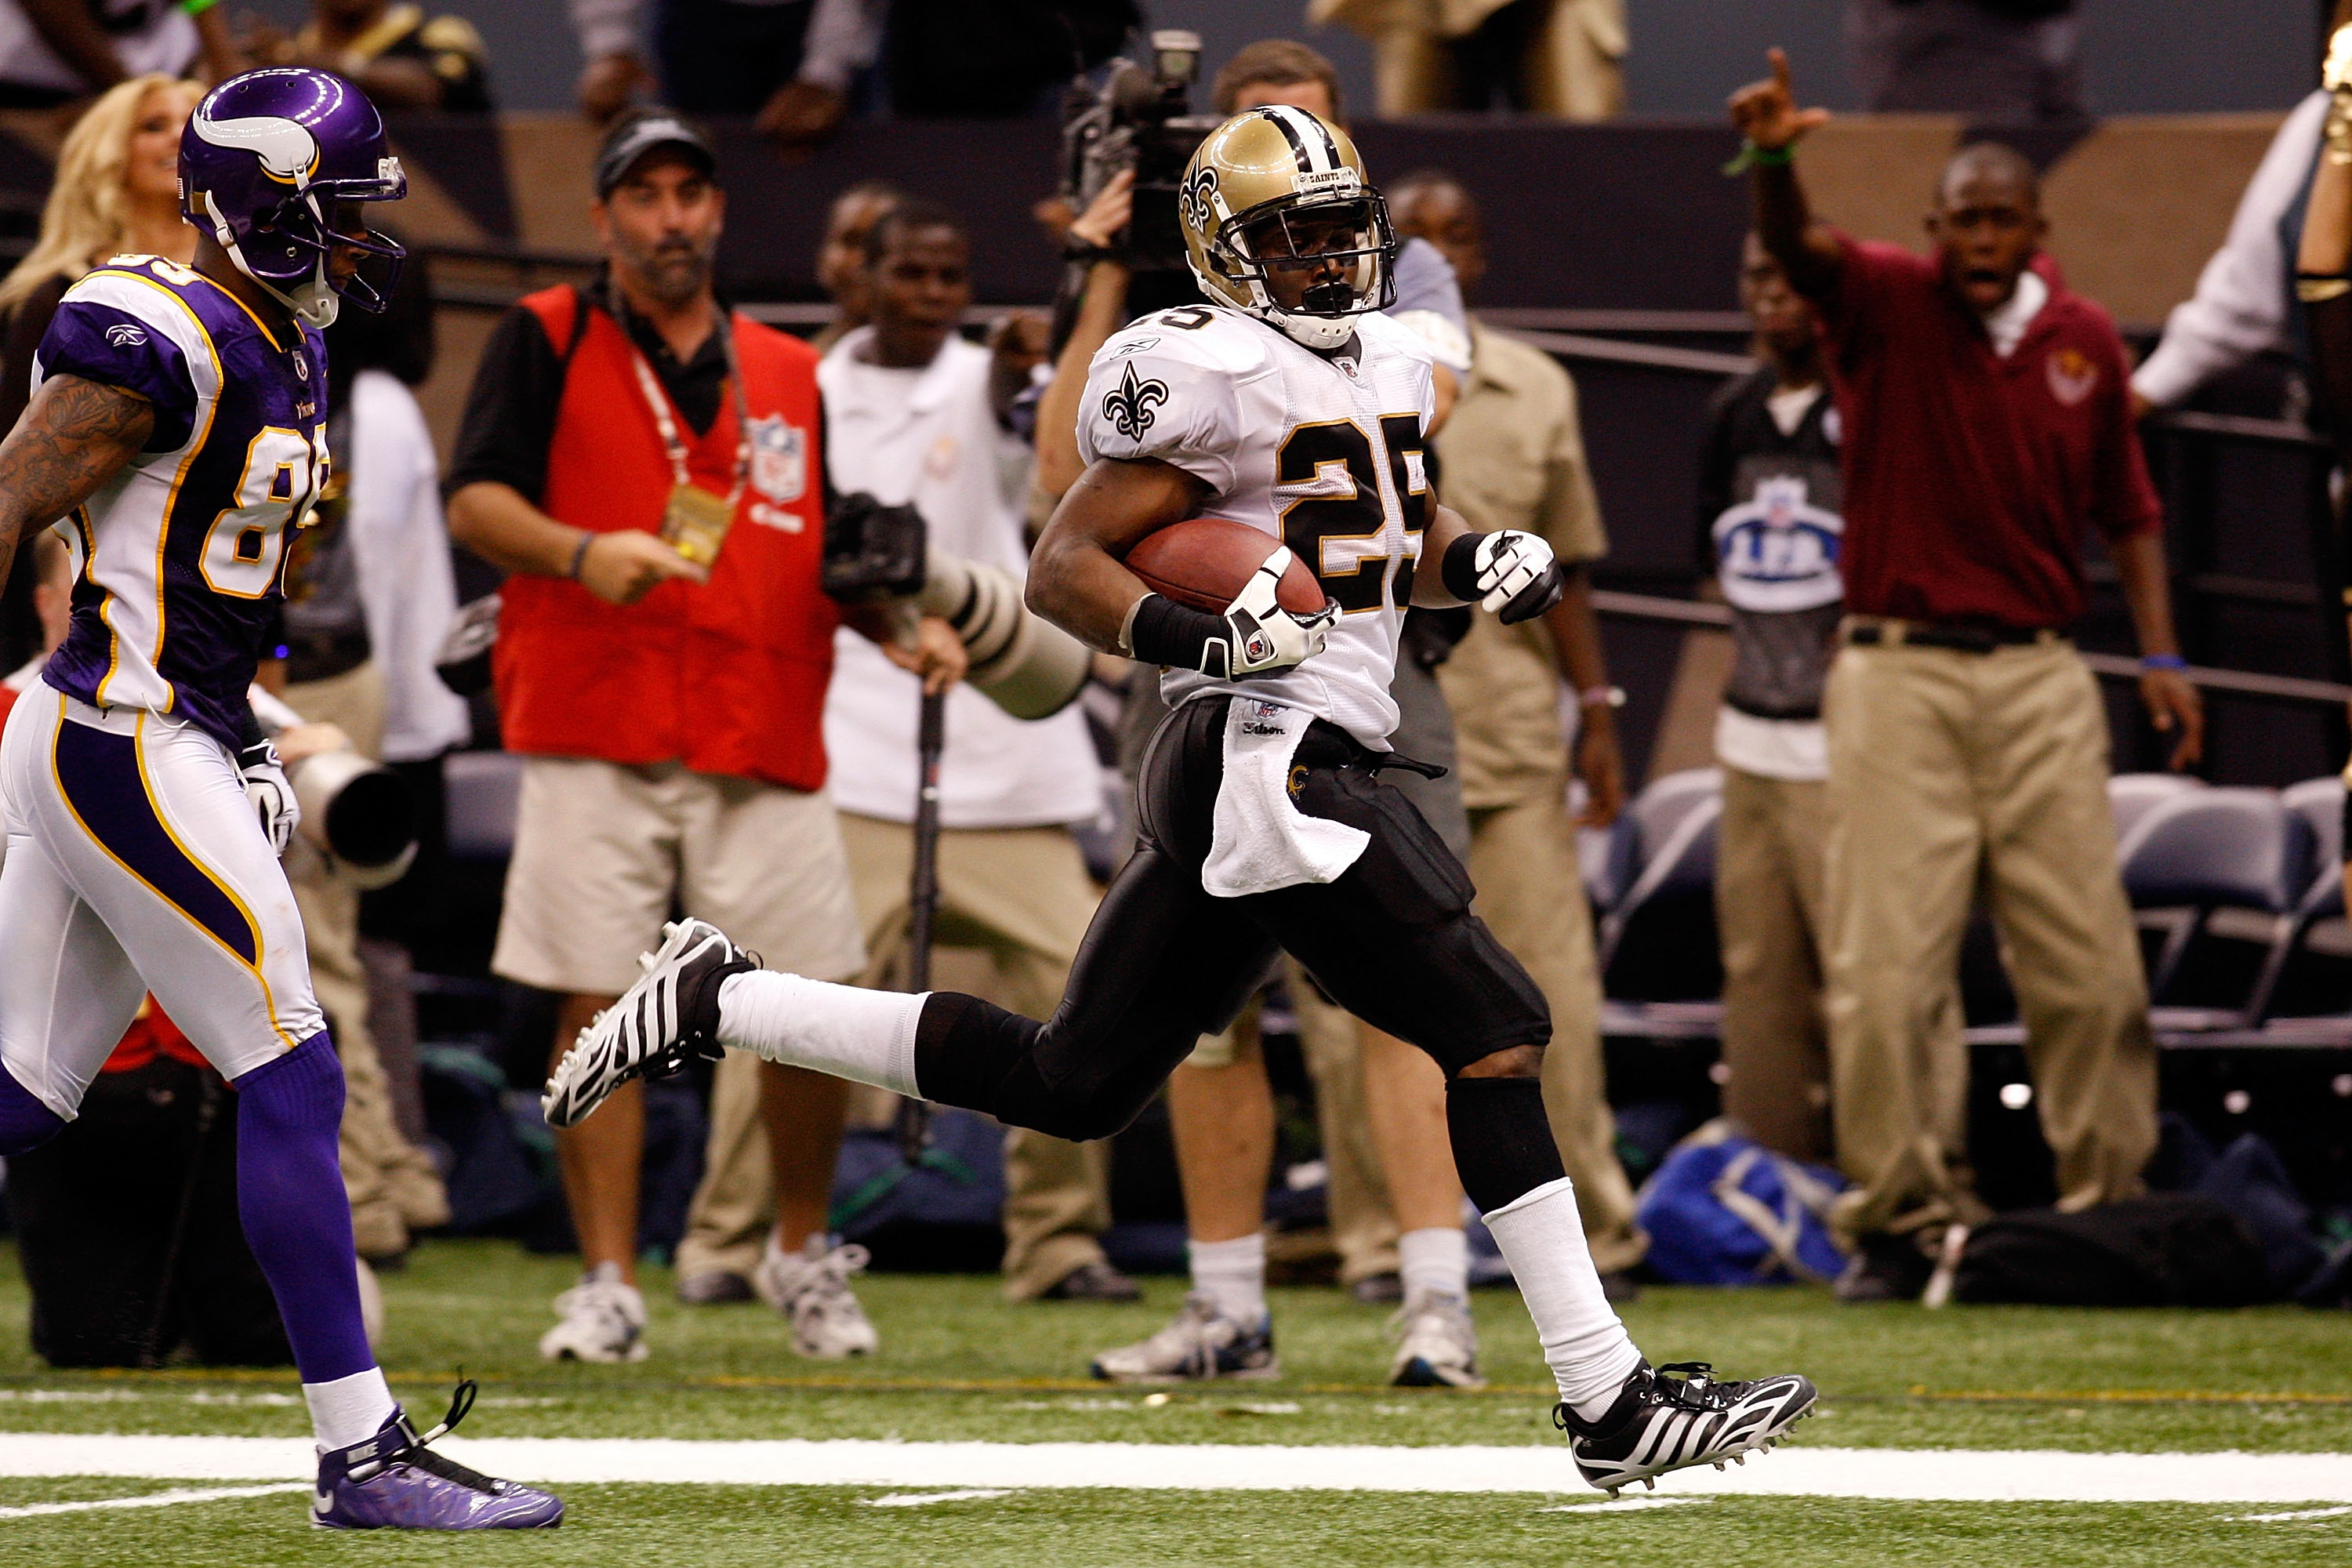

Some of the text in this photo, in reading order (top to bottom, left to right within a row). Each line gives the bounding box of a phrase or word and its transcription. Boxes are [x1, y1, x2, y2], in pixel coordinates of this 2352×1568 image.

[1309, 172, 1340, 183] SAINTS
[1276, 412, 1427, 615] 25
[347, 1440, 379, 1465] NIKE
